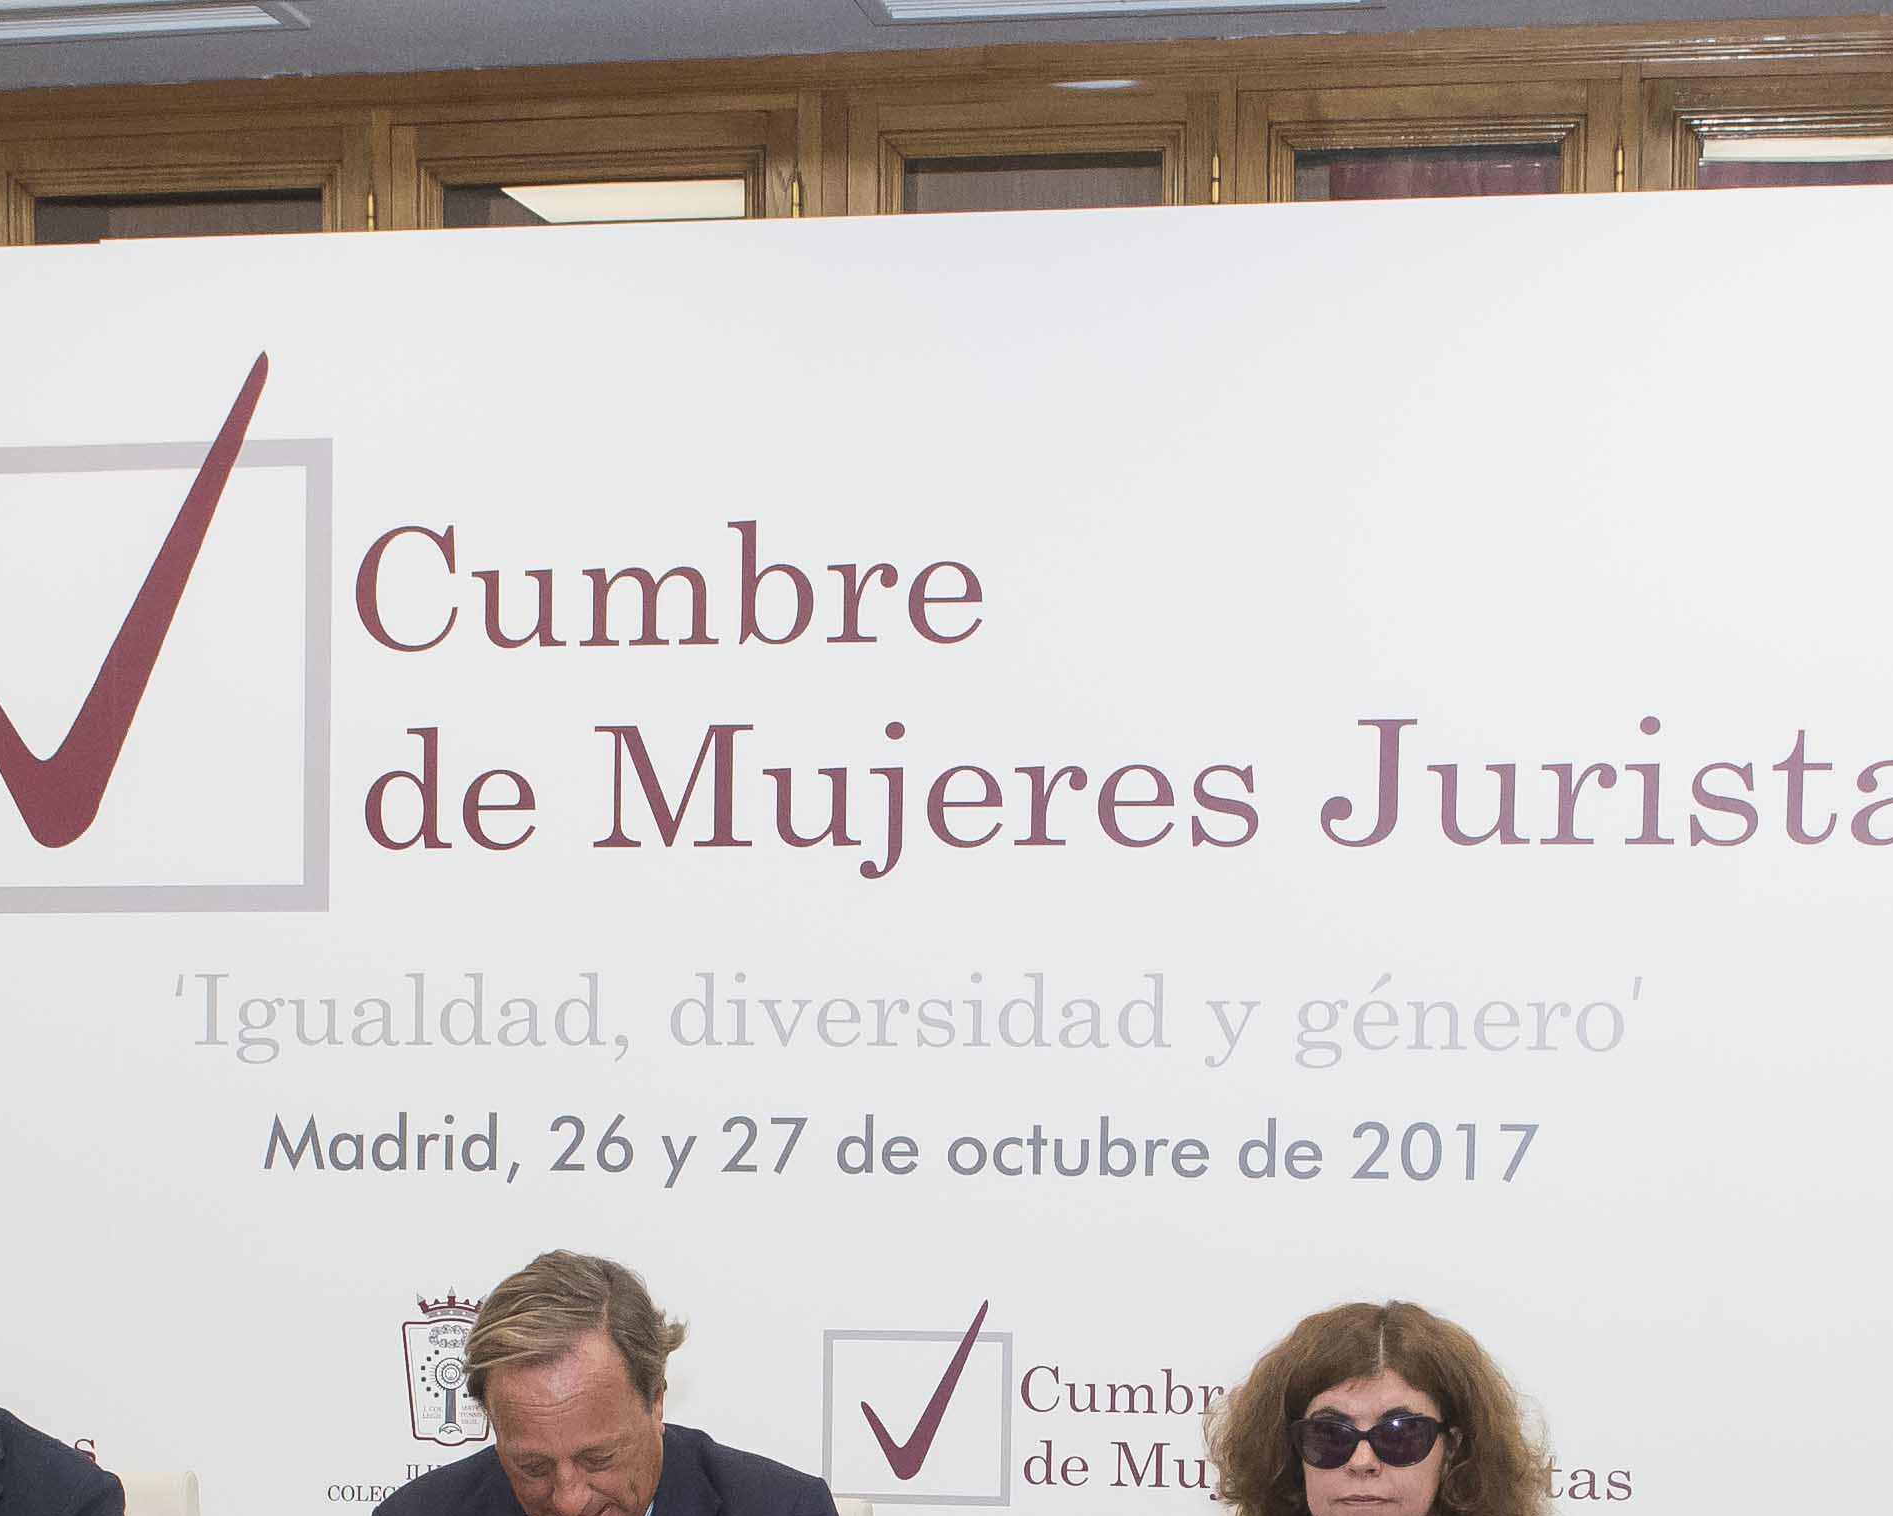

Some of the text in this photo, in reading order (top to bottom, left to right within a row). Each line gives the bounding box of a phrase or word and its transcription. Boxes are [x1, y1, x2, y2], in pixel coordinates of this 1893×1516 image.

[356, 520, 982, 652] Cumbre
[365, 727, 535, 850] de
[593, 722, 1258, 879] Mujeres
[175, 972, 1642, 1069] 'Igualdad, diversidad y género'
[264, 1112, 1539, 1188] Madrid, 26 y 27 de octubre de 2017
[1019, 1365, 1225, 1416] Cumbr
[1024, 1440, 1088, 1486] de
